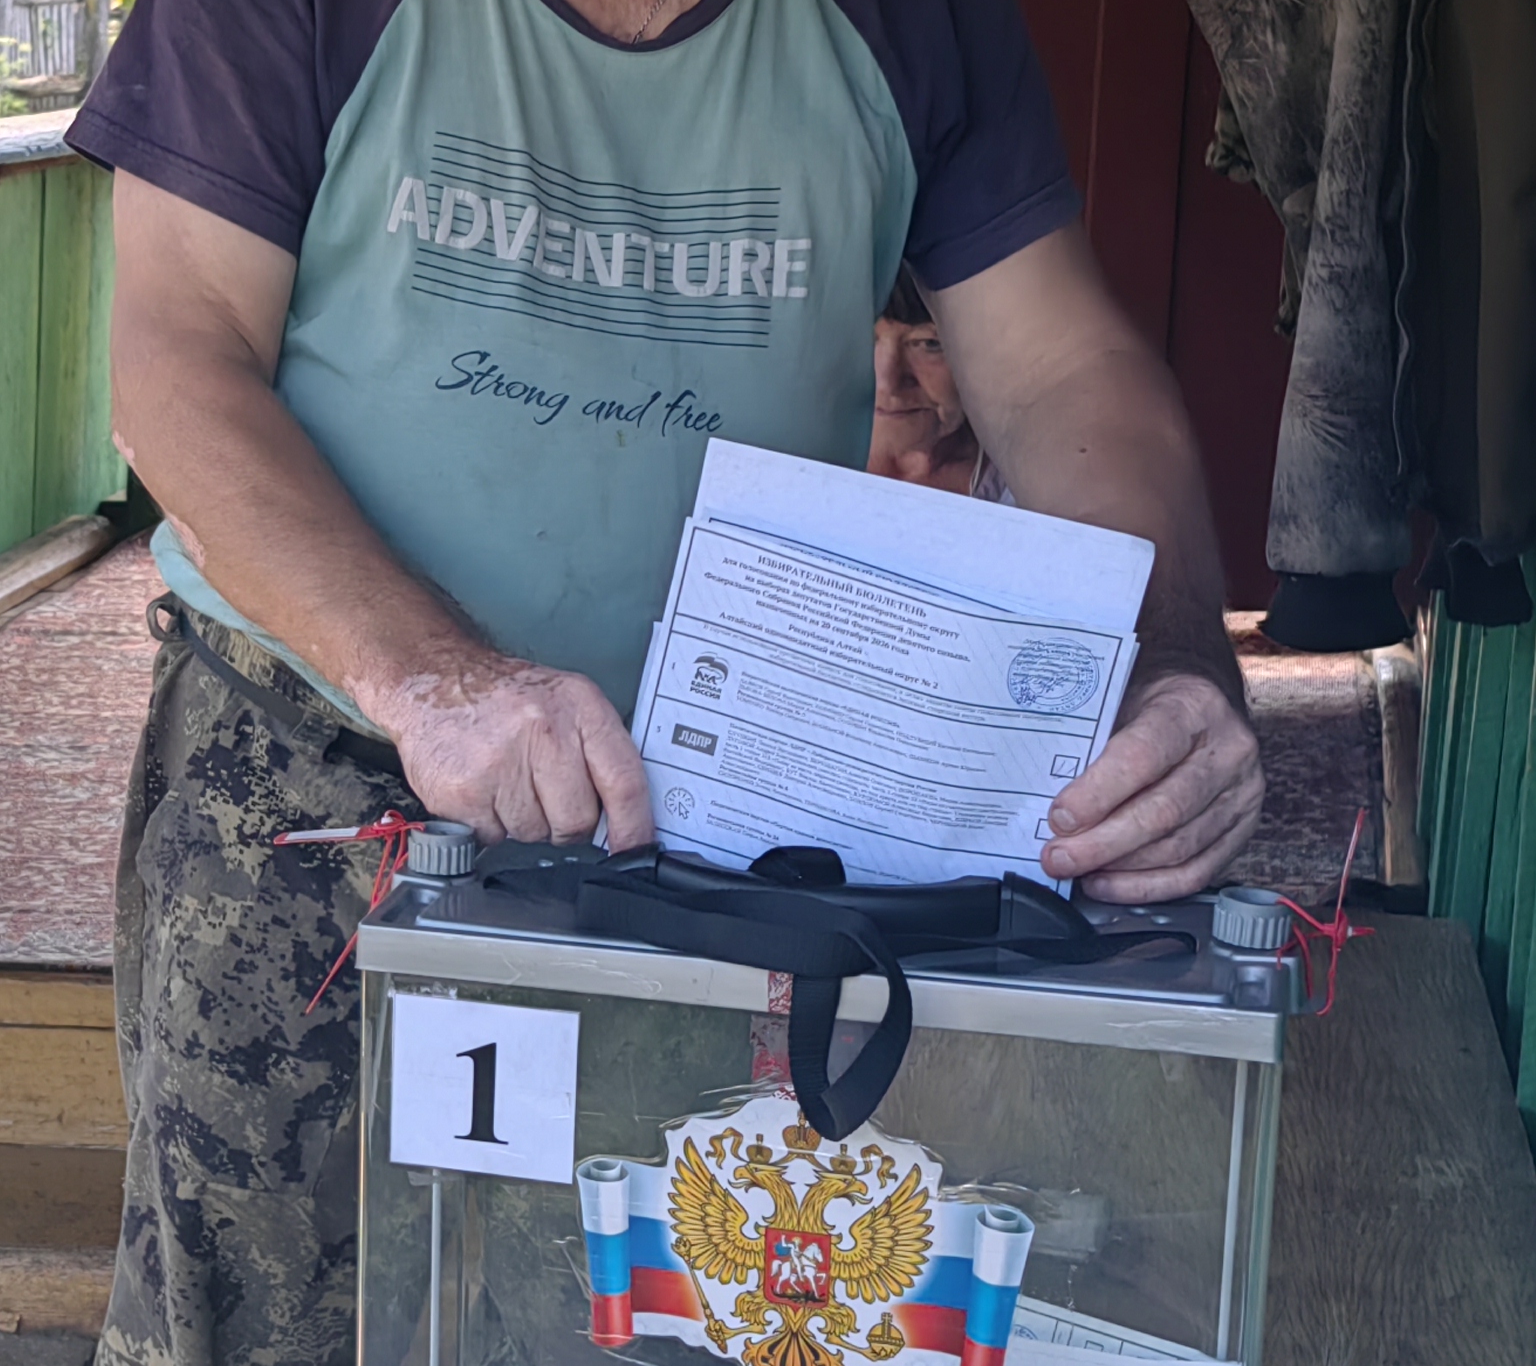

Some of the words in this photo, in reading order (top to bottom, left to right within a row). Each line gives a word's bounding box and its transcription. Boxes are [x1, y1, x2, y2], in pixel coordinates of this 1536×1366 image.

[386, 177, 812, 298] ADVENTURE
[436, 350, 569, 425] Strong
[582, 391, 662, 429] and
[661, 389, 724, 437] free
[758, 555, 854, 594] ИЗБИРАТЕЛЬНЫЙ
[855, 587, 927, 618] БЮЛЛЕТЕНЬ
[690, 686, 721, 700] РОССИЯ
[691, 680, 722, 694] ЕДИНАЯ
[678, 730, 712, 748] ЛДПР
[454, 1042, 509, 1145] 1
